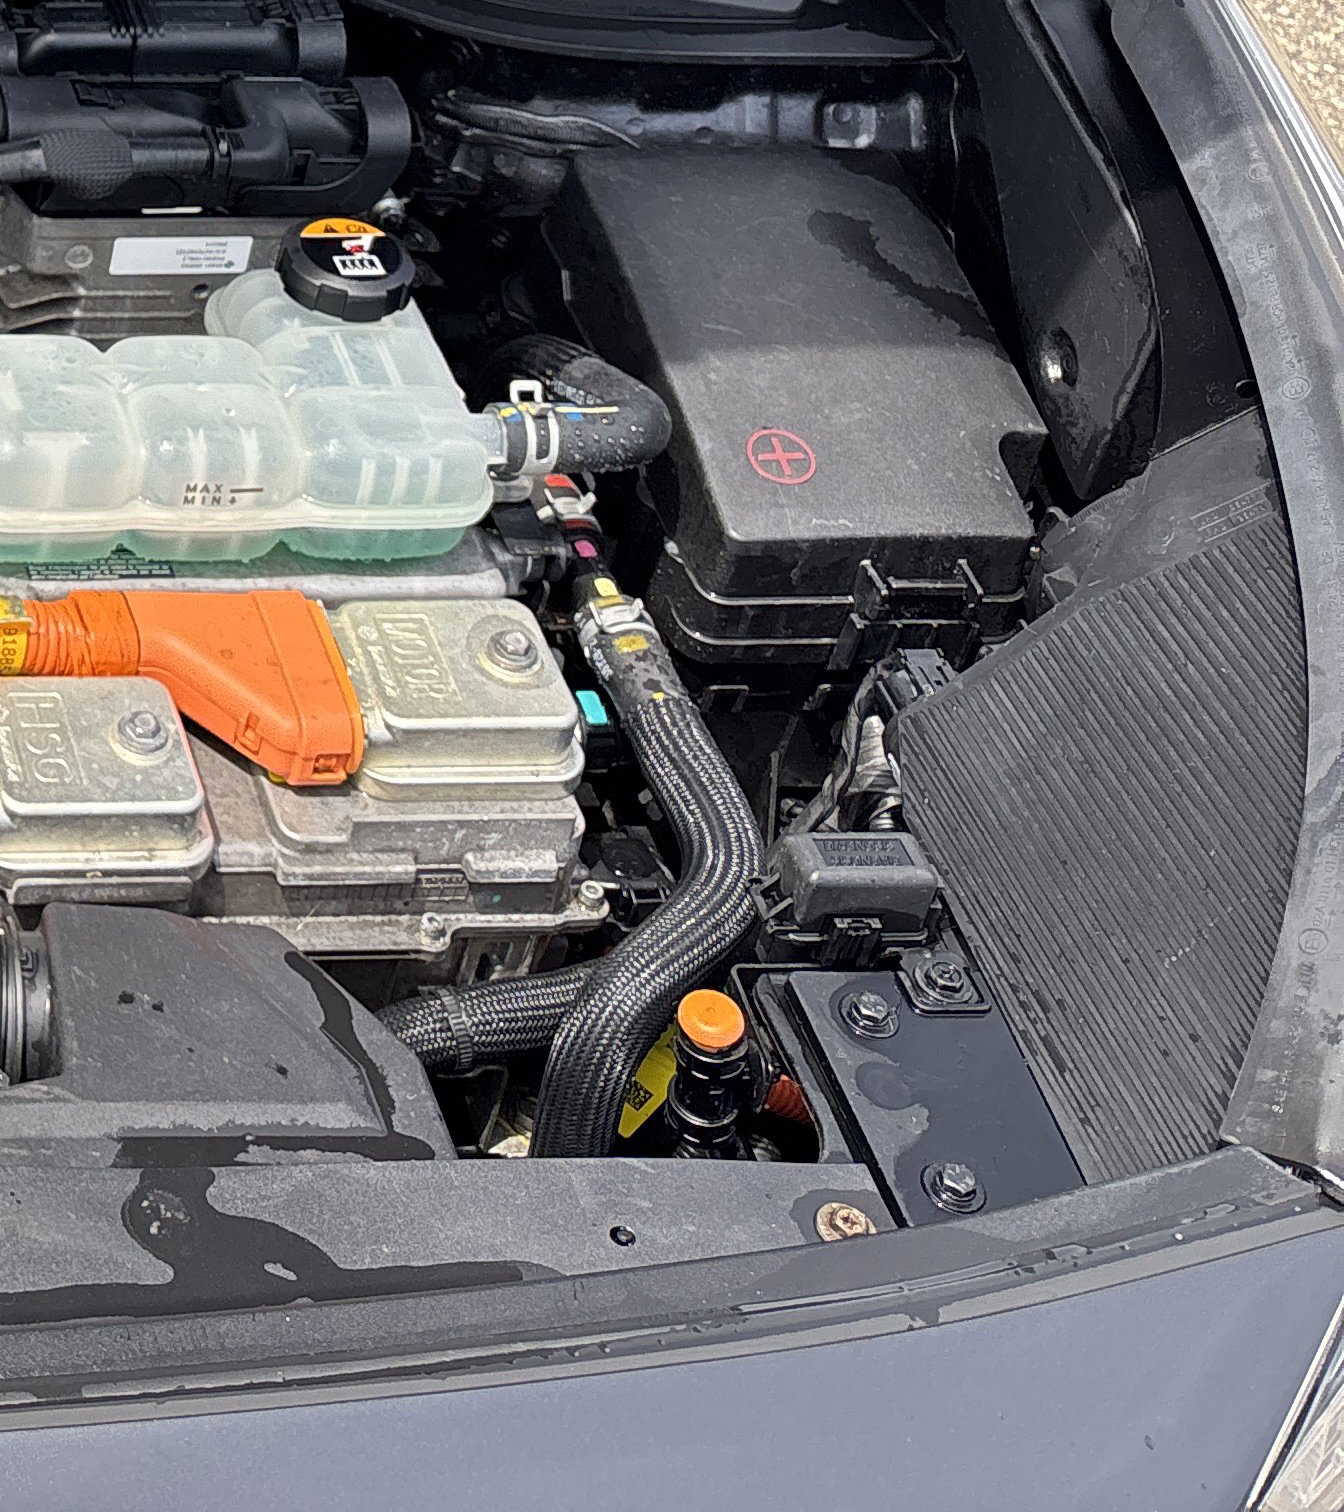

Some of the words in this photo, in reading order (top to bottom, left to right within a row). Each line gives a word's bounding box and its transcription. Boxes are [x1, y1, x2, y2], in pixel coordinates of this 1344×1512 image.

[183, 494, 222, 505] MIN
[185, 482, 224, 494] MAX
[380, 621, 451, 701] MOTOR
[14, 701, 73, 784] HSG
